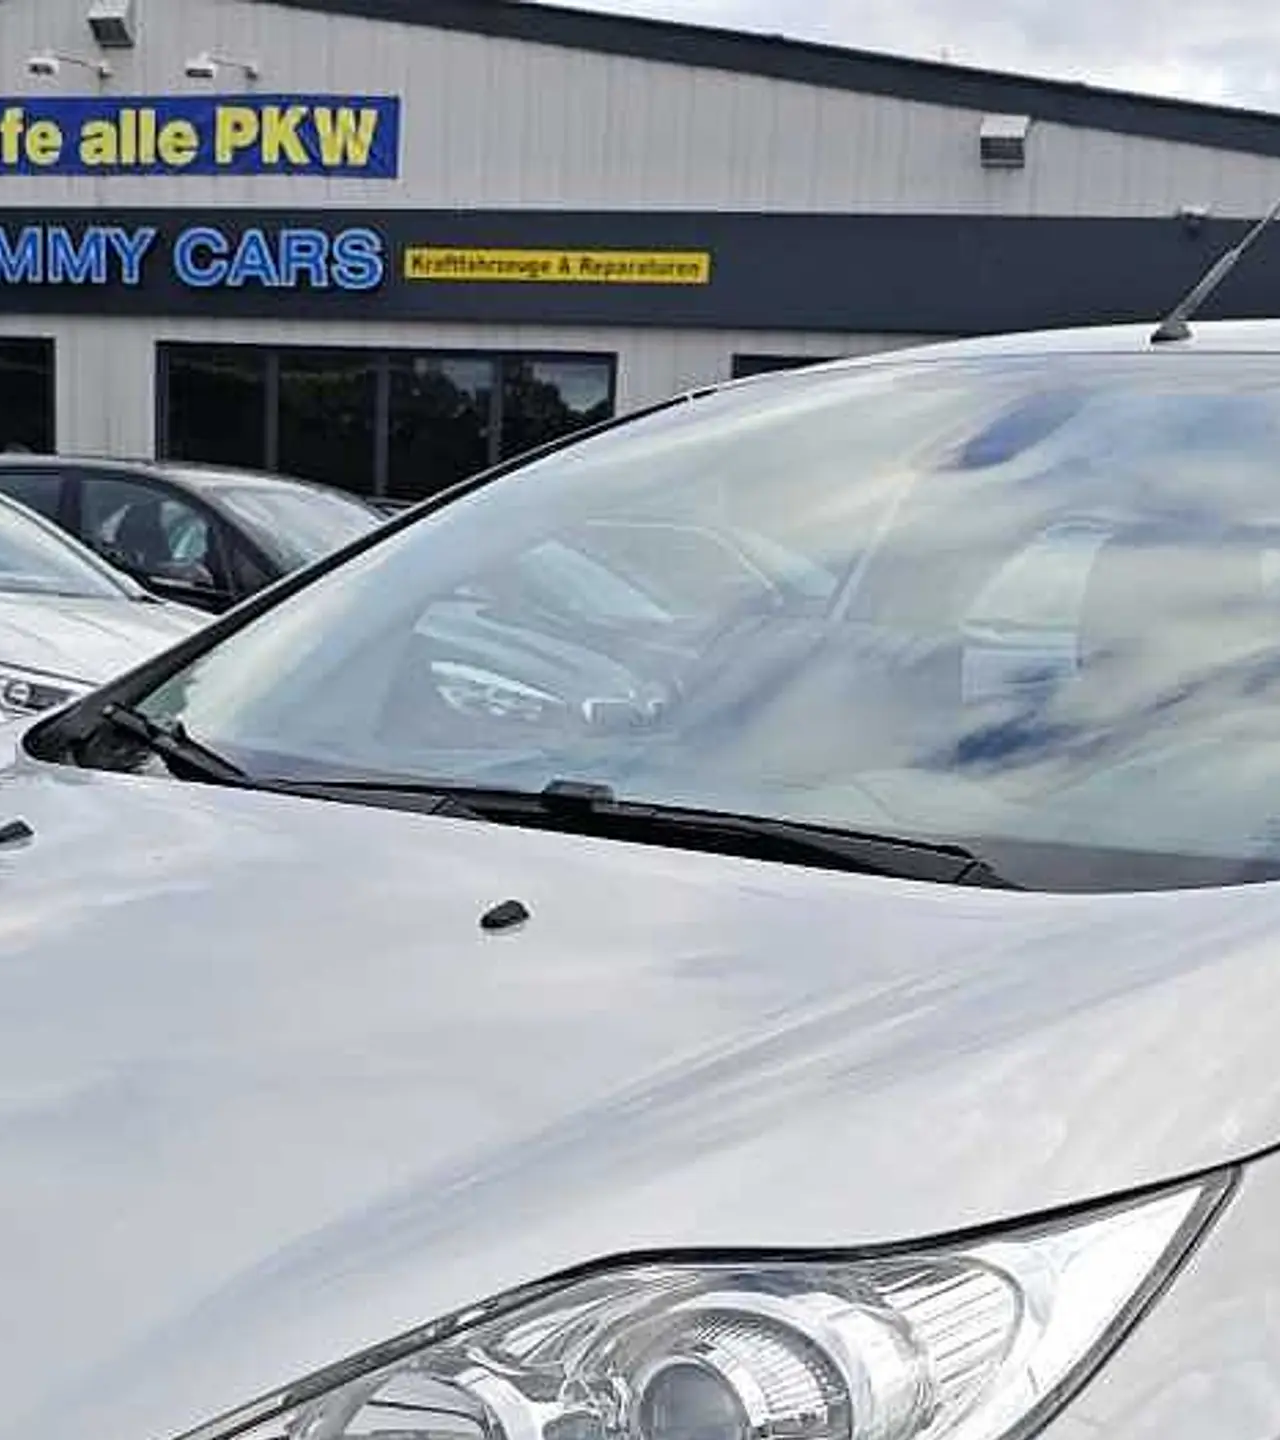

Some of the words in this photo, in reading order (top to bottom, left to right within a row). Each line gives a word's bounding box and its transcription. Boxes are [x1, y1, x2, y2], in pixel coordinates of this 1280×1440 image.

[80, 107, 200, 166] alle
[214, 105, 378, 168] PKW
[173, 227, 384, 290] CARS
